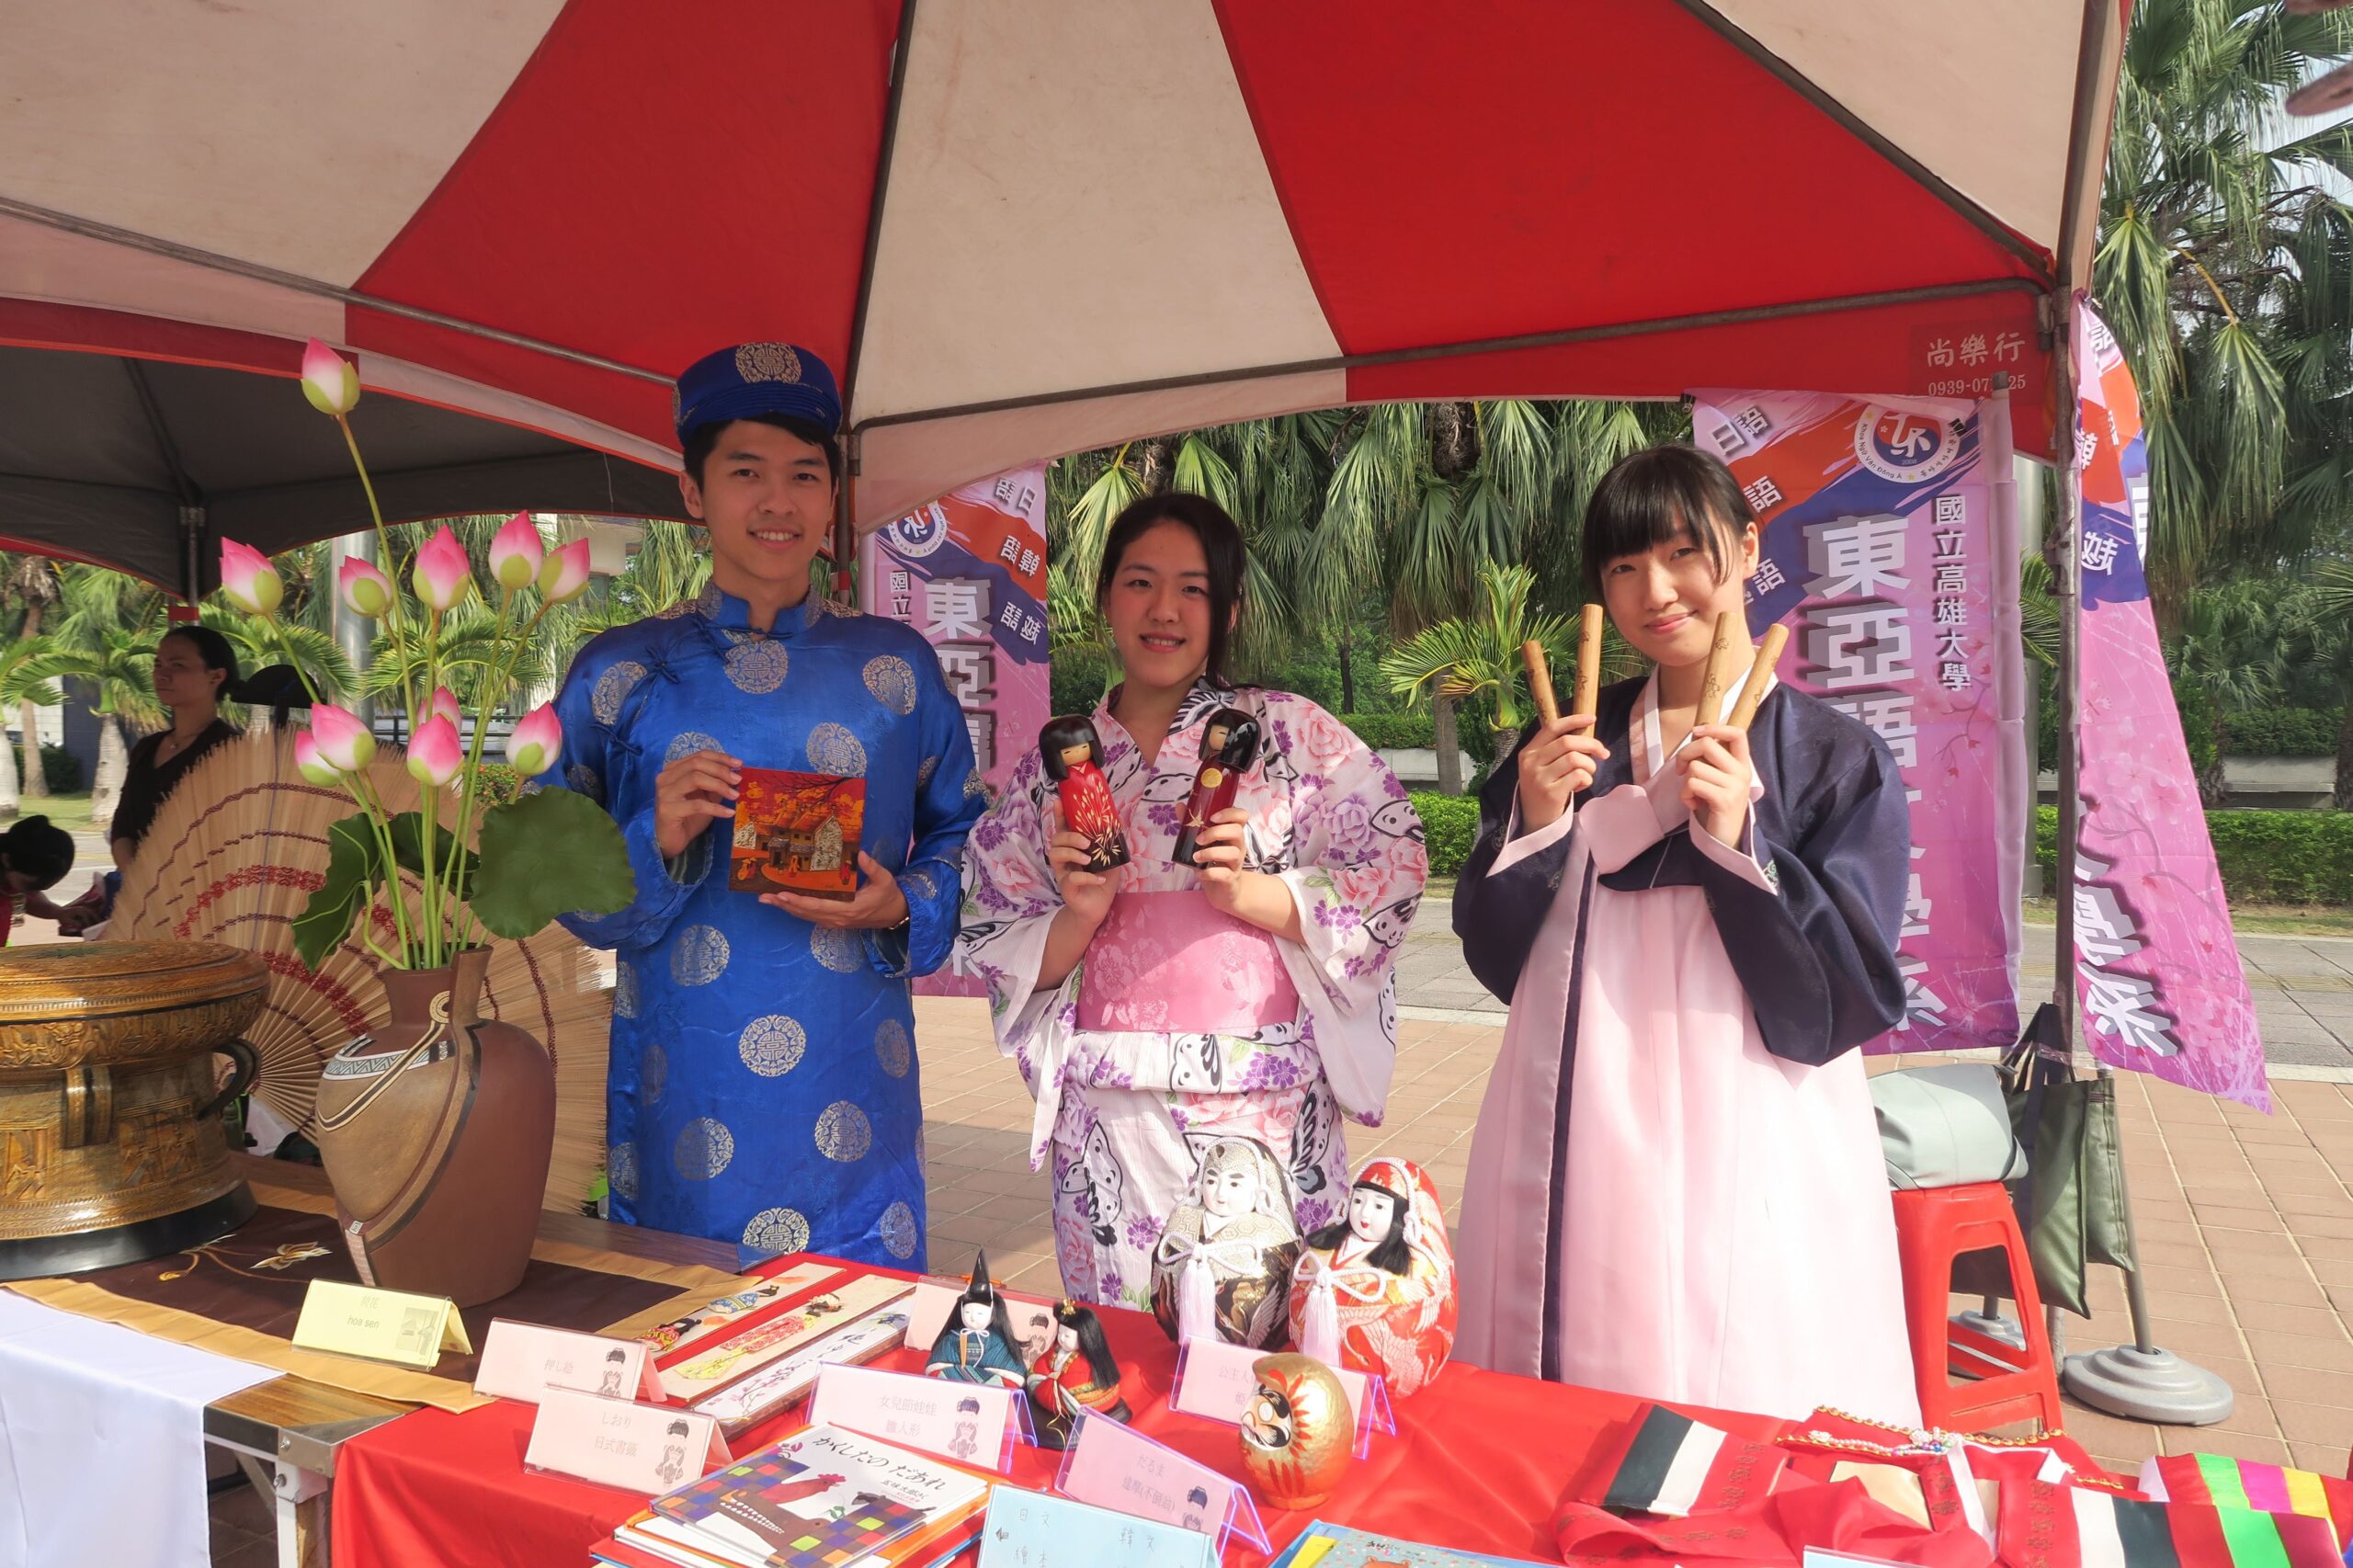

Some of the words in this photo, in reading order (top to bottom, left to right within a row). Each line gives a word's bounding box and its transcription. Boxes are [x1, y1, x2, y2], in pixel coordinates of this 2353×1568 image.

[1927, 332, 2026, 368] 尚樂行
[1928, 373, 2027, 397] 0939-0725
[1711, 405, 1769, 456] 日語
[1934, 494, 1972, 693] 國立高雄大學
[347, 1314, 363, 1326] hoa
[364, 1319, 380, 1329] sen
[602, 1411, 631, 1428] しおり
[812, 1437, 890, 1468] かくしたの
[889, 1465, 947, 1491] だあれ
